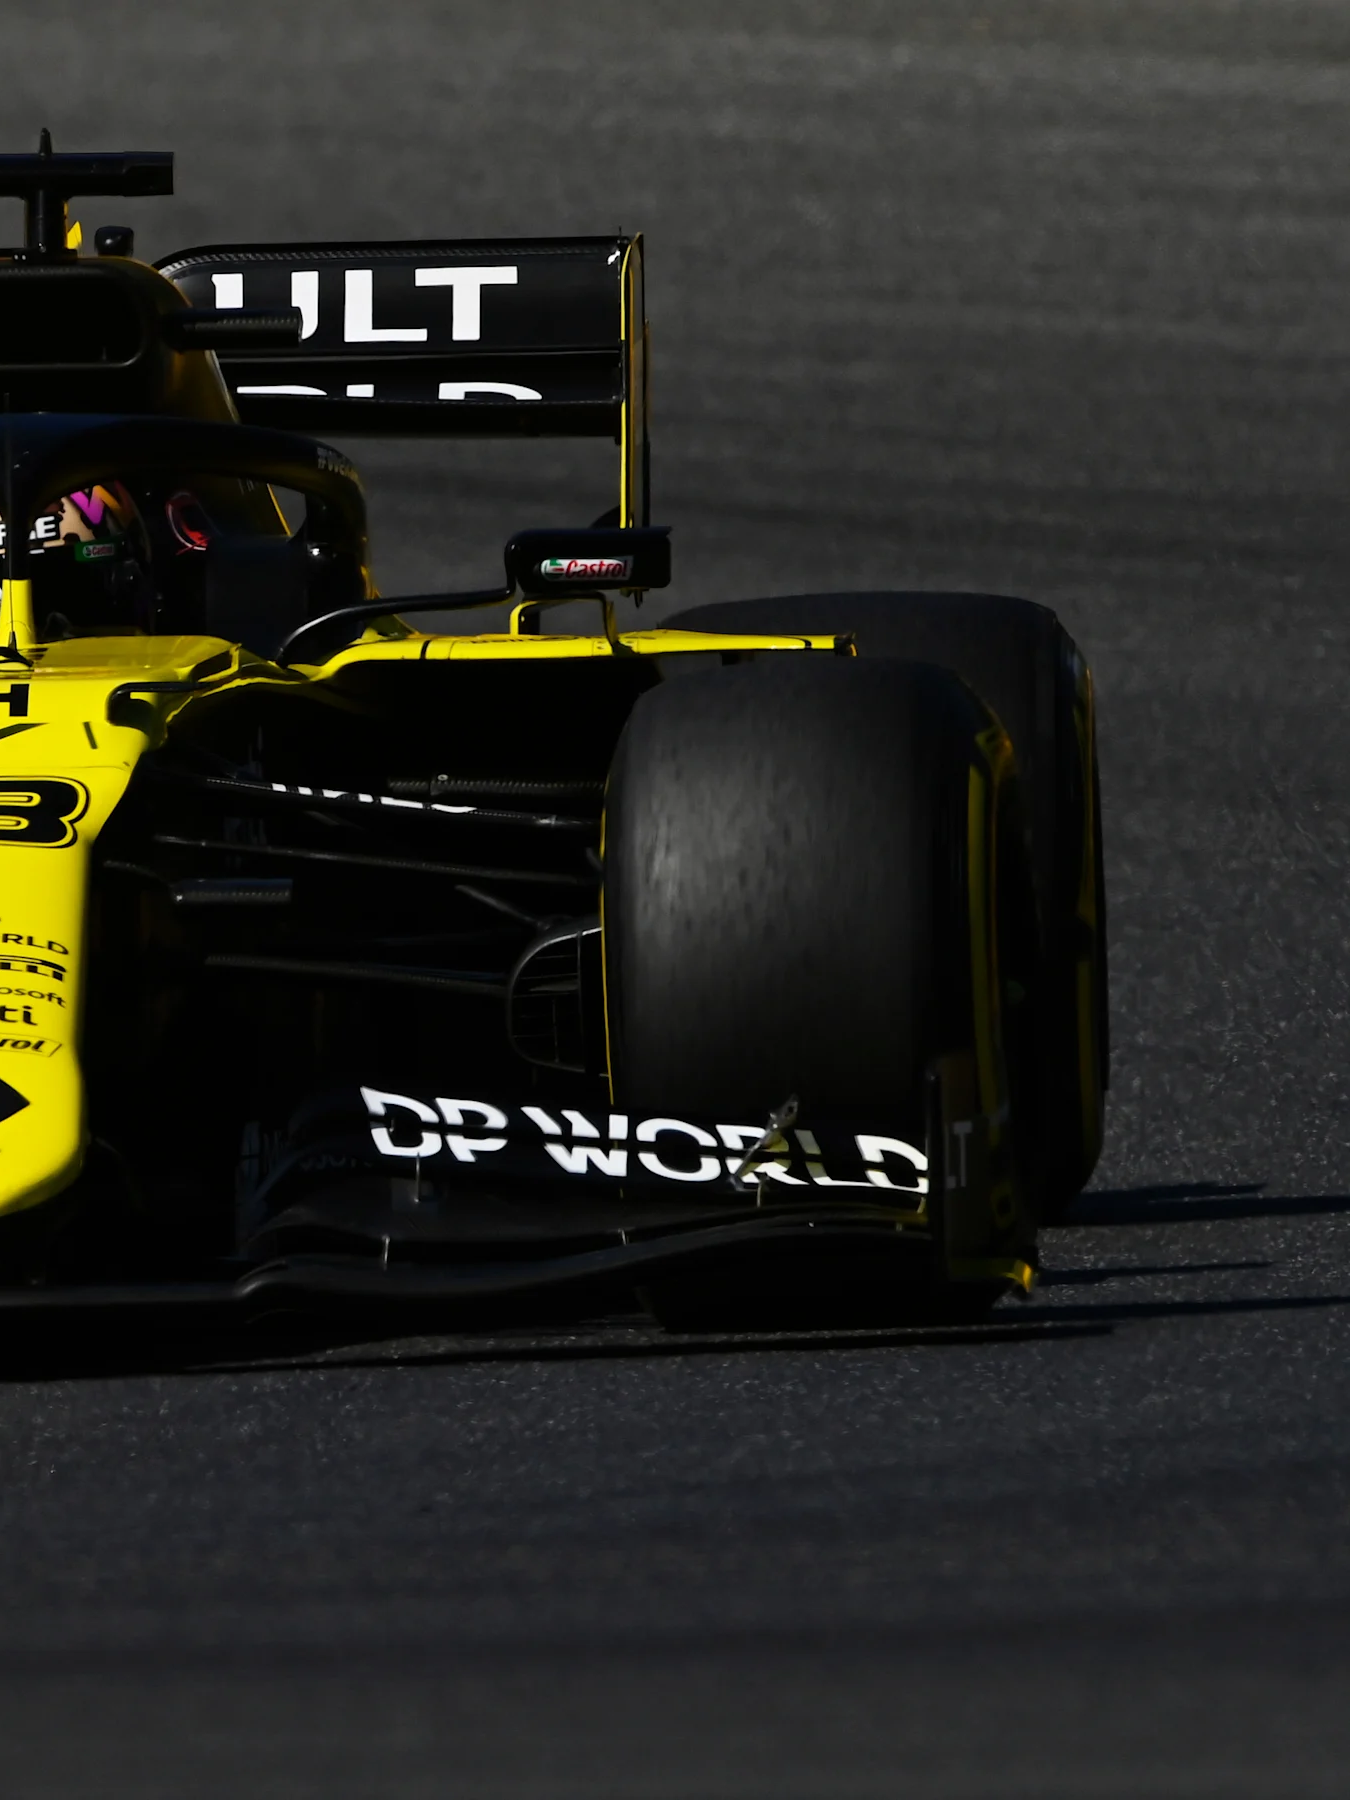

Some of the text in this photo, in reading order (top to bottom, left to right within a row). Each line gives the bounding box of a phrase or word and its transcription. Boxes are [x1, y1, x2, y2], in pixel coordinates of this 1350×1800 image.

[565, 559, 628, 579] Castrol
[359, 1084, 510, 1164] DP
[518, 1105, 931, 1195] WORLD
